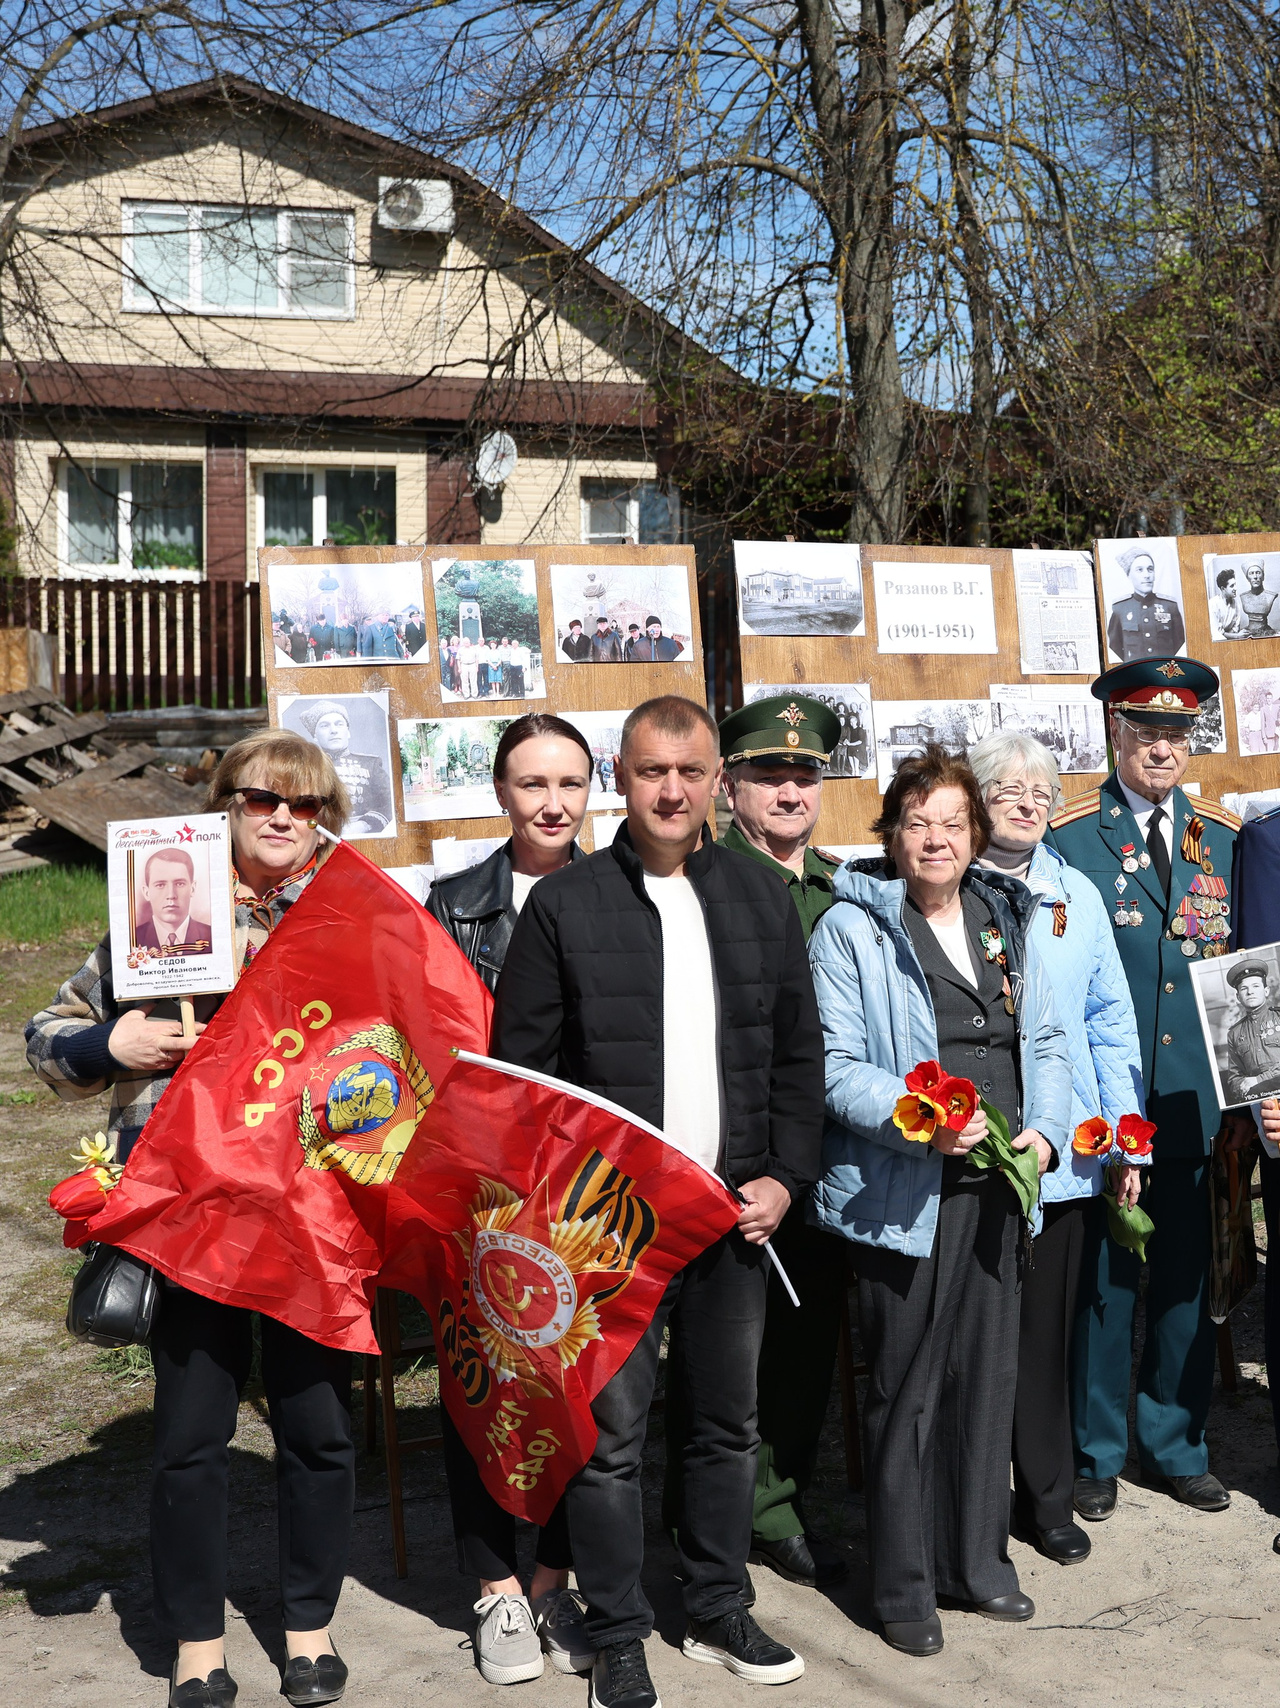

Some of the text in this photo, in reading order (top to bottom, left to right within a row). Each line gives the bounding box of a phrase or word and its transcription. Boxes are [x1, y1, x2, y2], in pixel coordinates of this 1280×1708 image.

[884, 580, 983, 596] Рязанов В.Г.
[887, 623, 975, 641] (1901-1951)
[158, 958, 186, 966] СЕДОВ
[138, 965, 207, 977] Виктор Иванович
